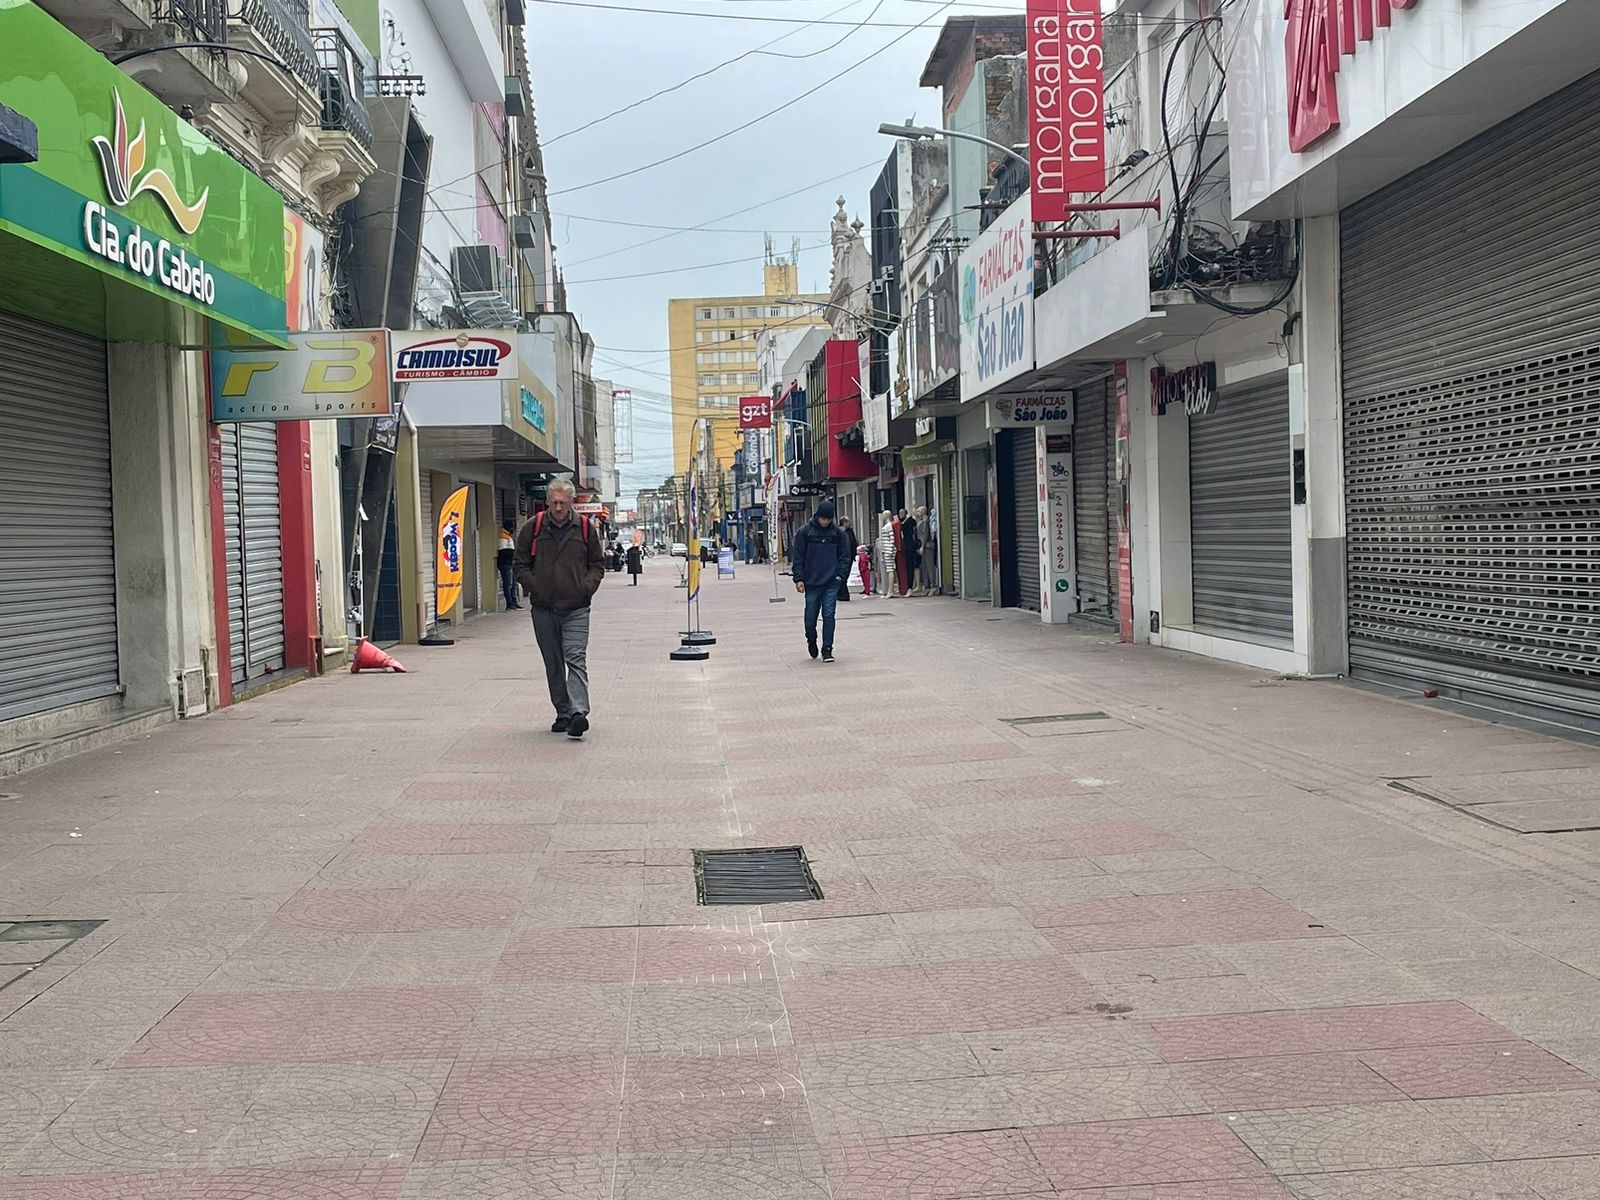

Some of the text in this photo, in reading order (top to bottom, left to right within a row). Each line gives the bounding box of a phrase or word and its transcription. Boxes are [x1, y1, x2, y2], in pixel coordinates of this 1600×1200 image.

[1034, 15, 1064, 193] morgana
[84, 200, 124, 264] Cia.
[127, 224, 154, 277] do
[157, 239, 215, 305] Cabelo
[979, 218, 1024, 301] FARMÁCIAS
[977, 281, 1024, 382] São João
[397, 349, 499, 369] CAMBISUL
[227, 400, 377, 413] action sports
[1015, 395, 1066, 407] FARMÁCIAS
[742, 403, 768, 422] gzt
[1013, 406, 1068, 421] São João
